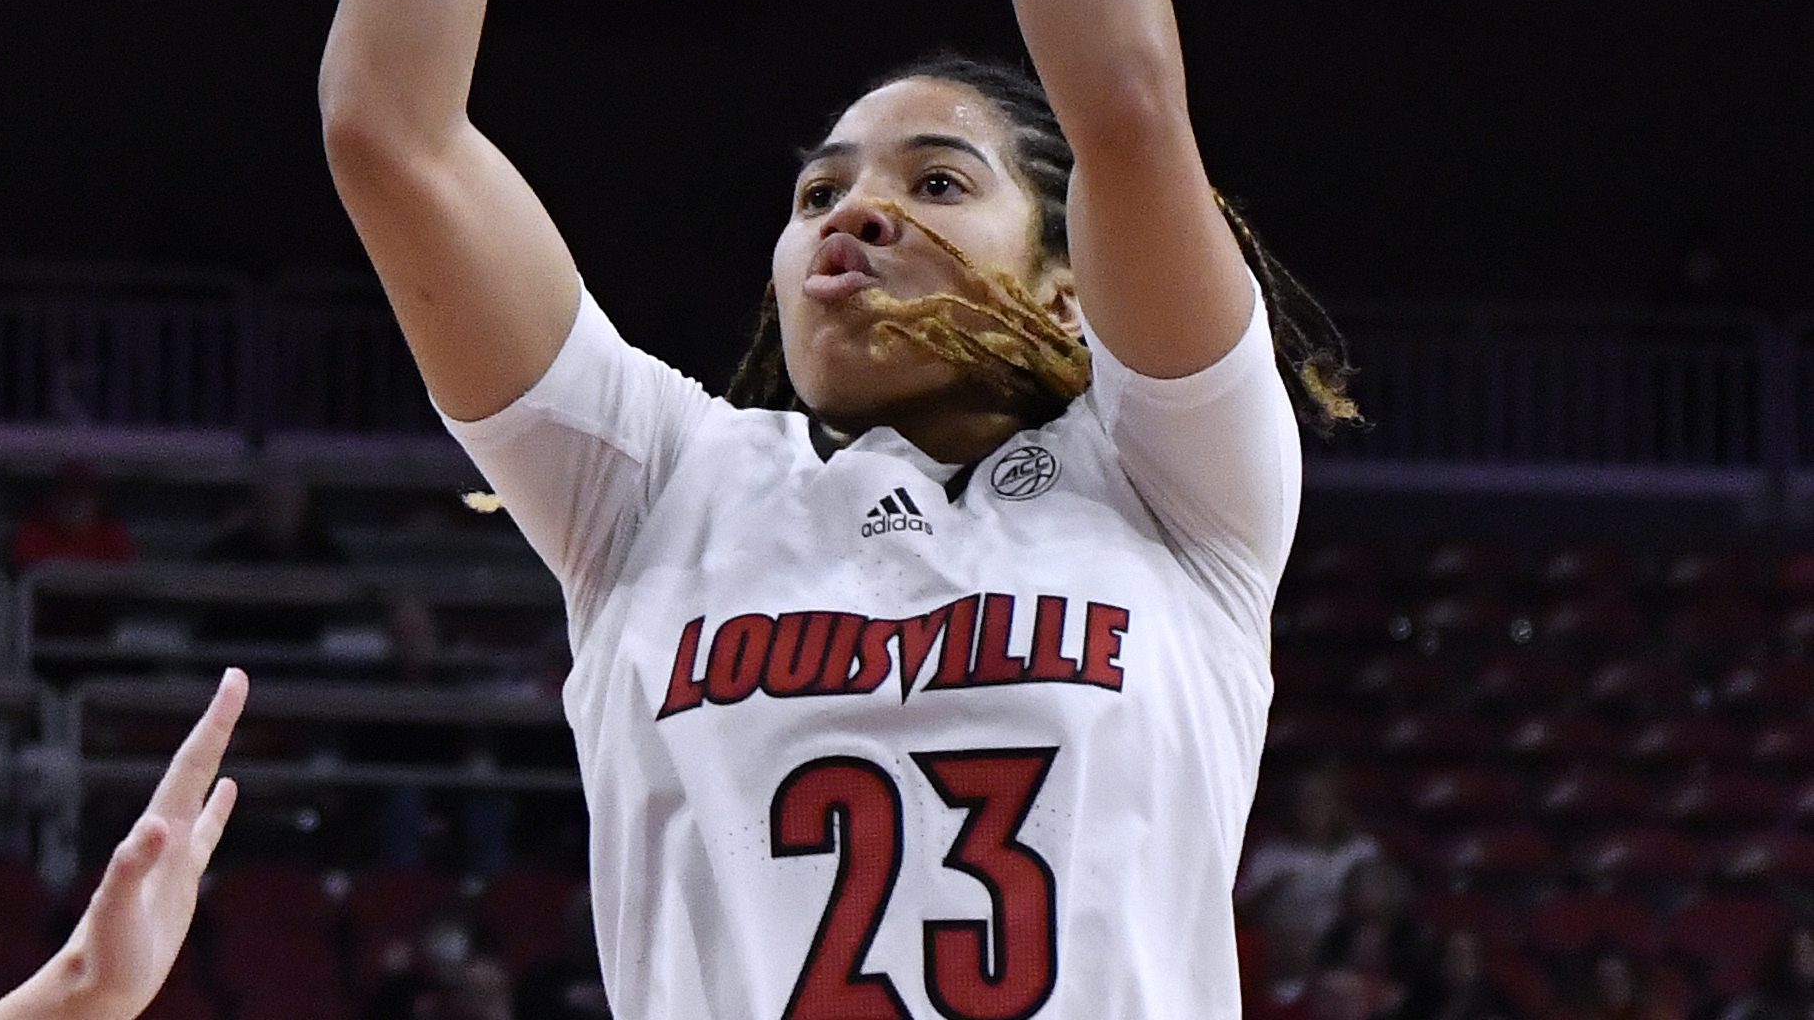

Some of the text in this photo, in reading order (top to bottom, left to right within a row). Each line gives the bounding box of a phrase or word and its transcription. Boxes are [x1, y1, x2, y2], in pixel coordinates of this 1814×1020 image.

[997, 453, 1051, 487] ACC
[861, 514, 933, 538] adidas
[656, 592, 1130, 721] LOUISVILLE
[769, 746, 1059, 1020] 23
